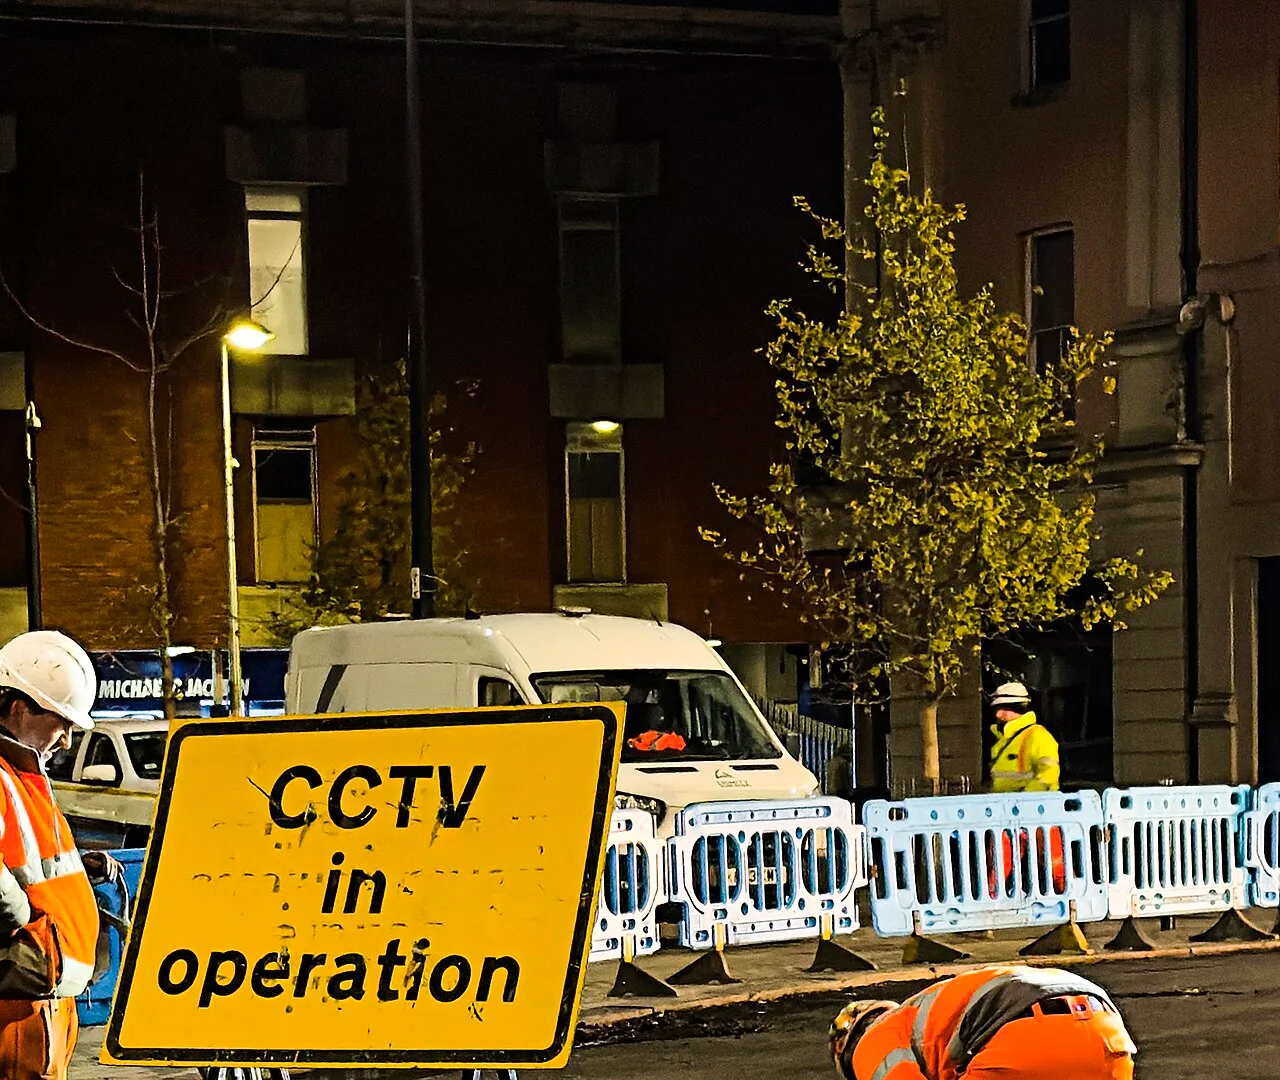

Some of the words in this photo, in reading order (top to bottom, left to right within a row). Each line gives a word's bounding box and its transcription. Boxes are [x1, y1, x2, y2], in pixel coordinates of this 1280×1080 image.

[98, 678, 166, 699] MICHAE
[184, 677, 250, 698] JACN
[267, 764, 487, 829] CCTV
[321, 851, 387, 915] in
[157, 937, 521, 1008] operation
